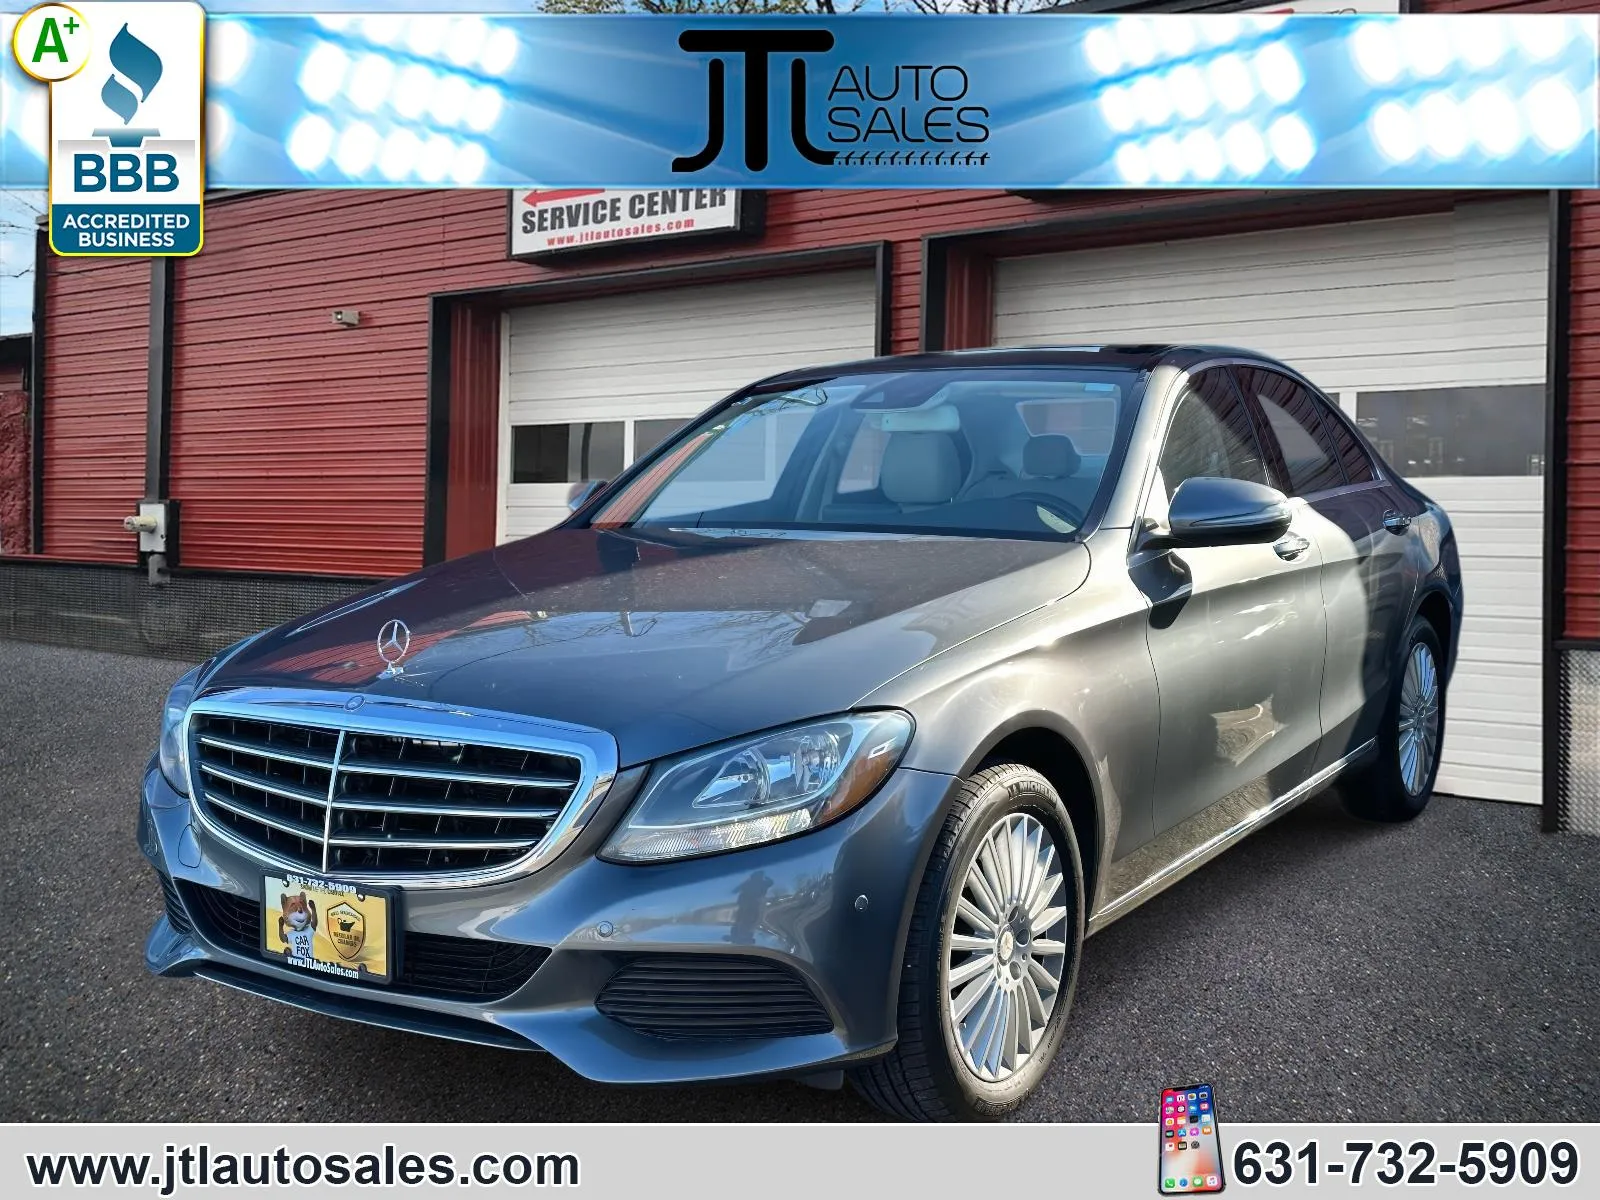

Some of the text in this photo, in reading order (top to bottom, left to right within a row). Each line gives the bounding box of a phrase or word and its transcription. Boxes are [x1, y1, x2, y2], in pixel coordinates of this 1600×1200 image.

[521, 188, 727, 235] SERVICE CENTER
[546, 217, 696, 247] www.jtlautosales.com
[294, 935, 310, 947] CAR
[296, 946, 310, 959] FOX
